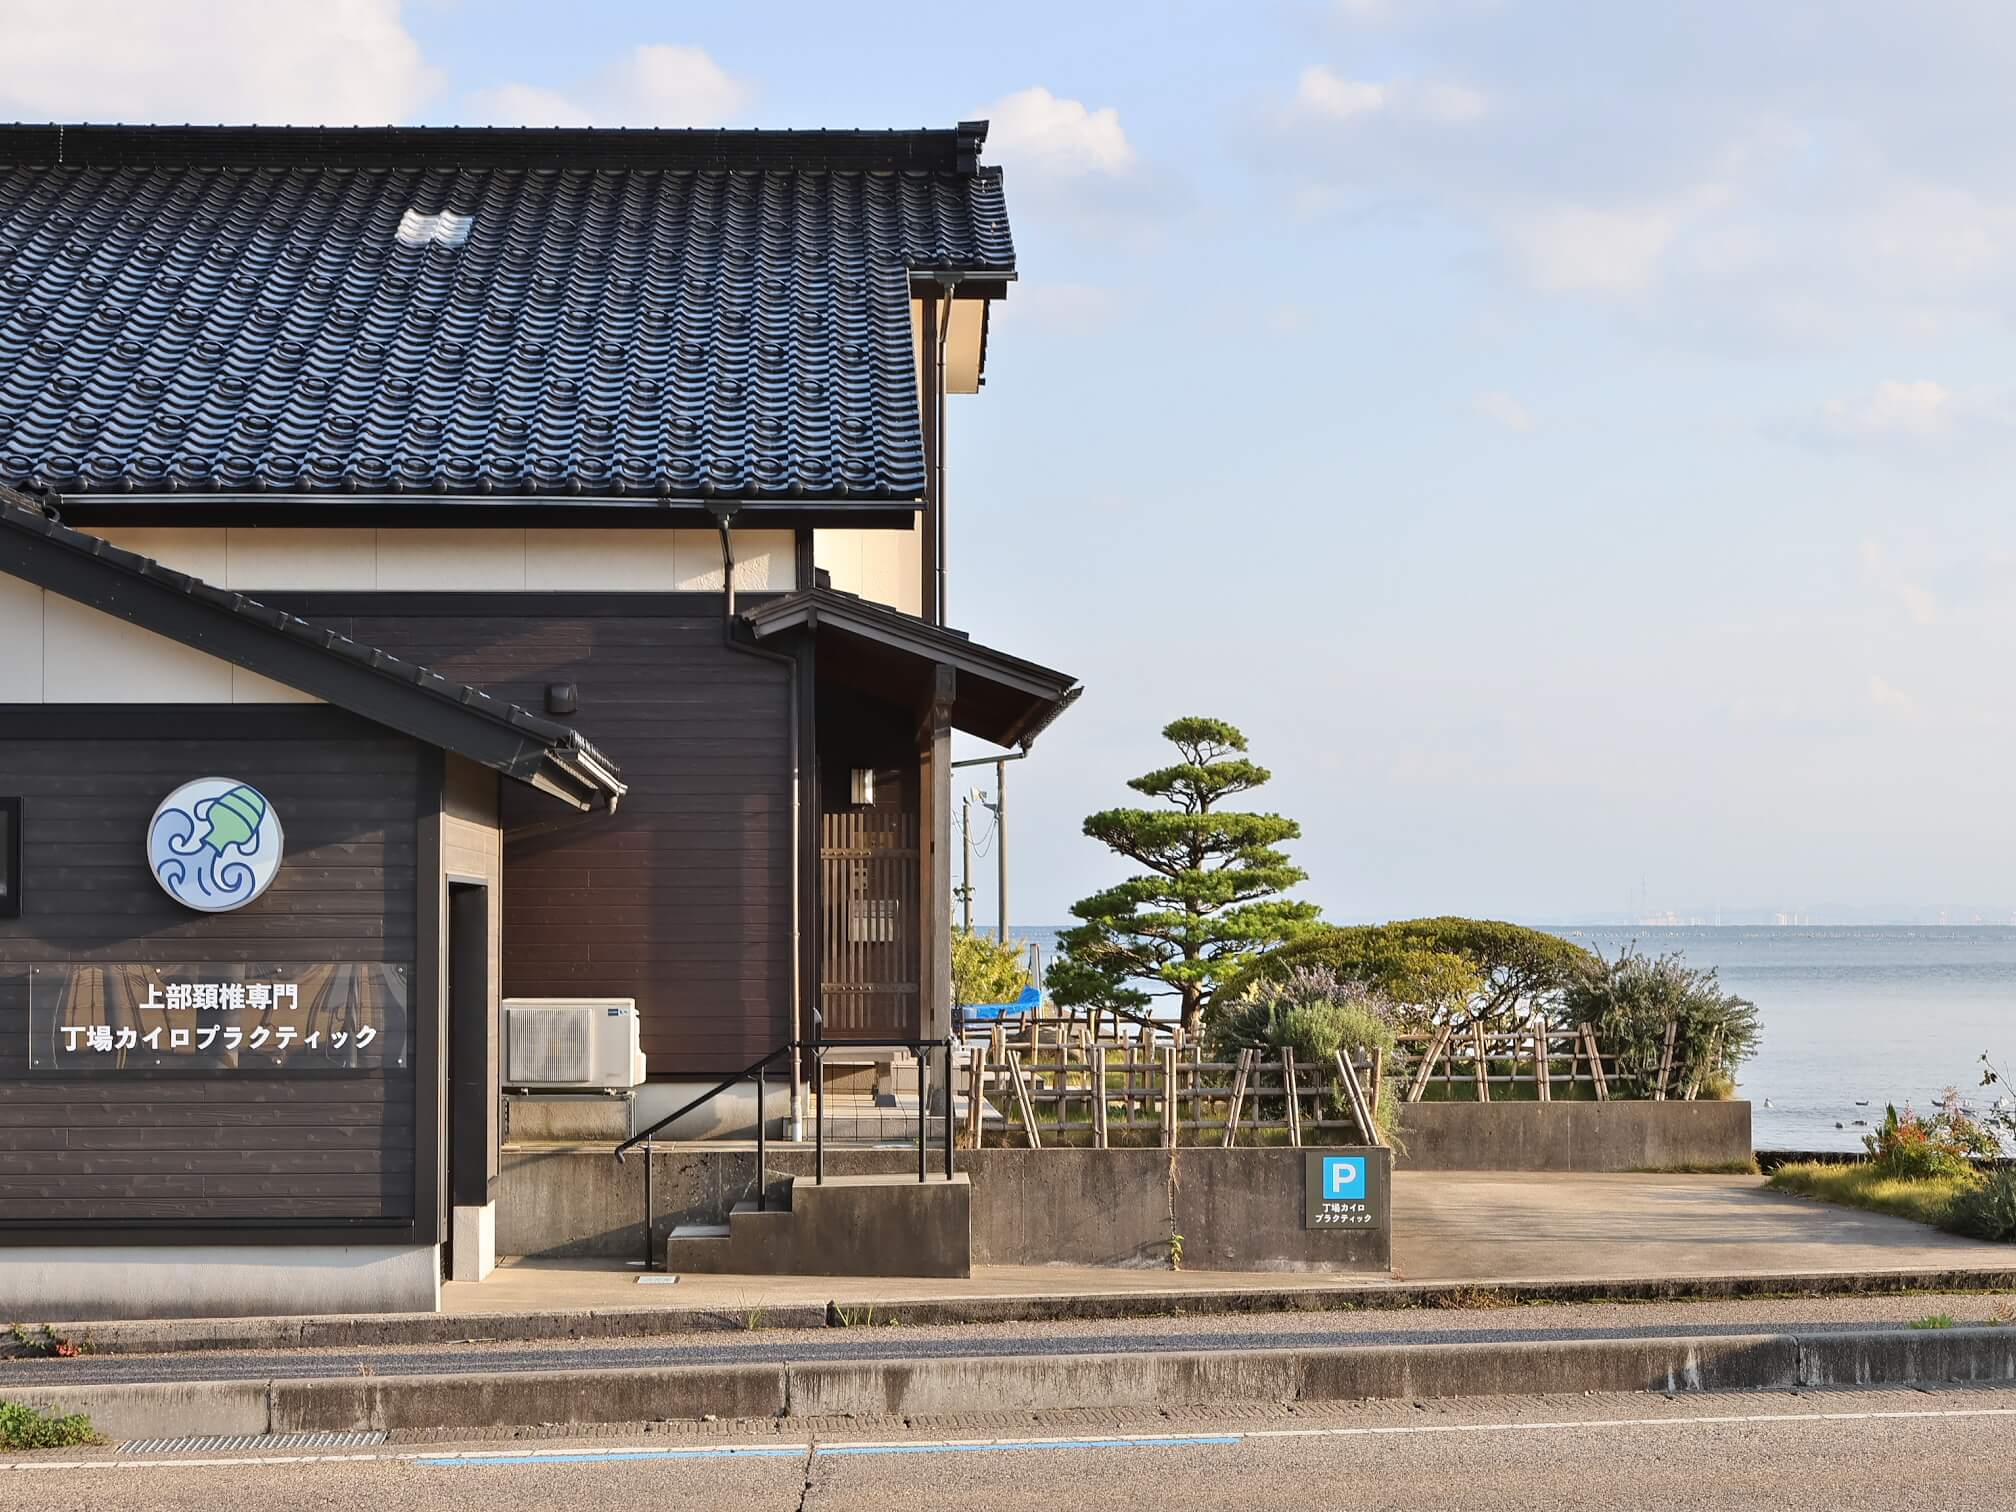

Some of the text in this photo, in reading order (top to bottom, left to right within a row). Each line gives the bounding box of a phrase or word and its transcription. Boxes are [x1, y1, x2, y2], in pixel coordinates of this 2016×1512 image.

[60, 1025, 377, 1051] 丁場カイロプラクティック
[1332, 1163, 1357, 1193] P
[1322, 1203, 1365, 1213] 丁場カイロ
[1315, 1214, 1372, 1223] プラクティック
